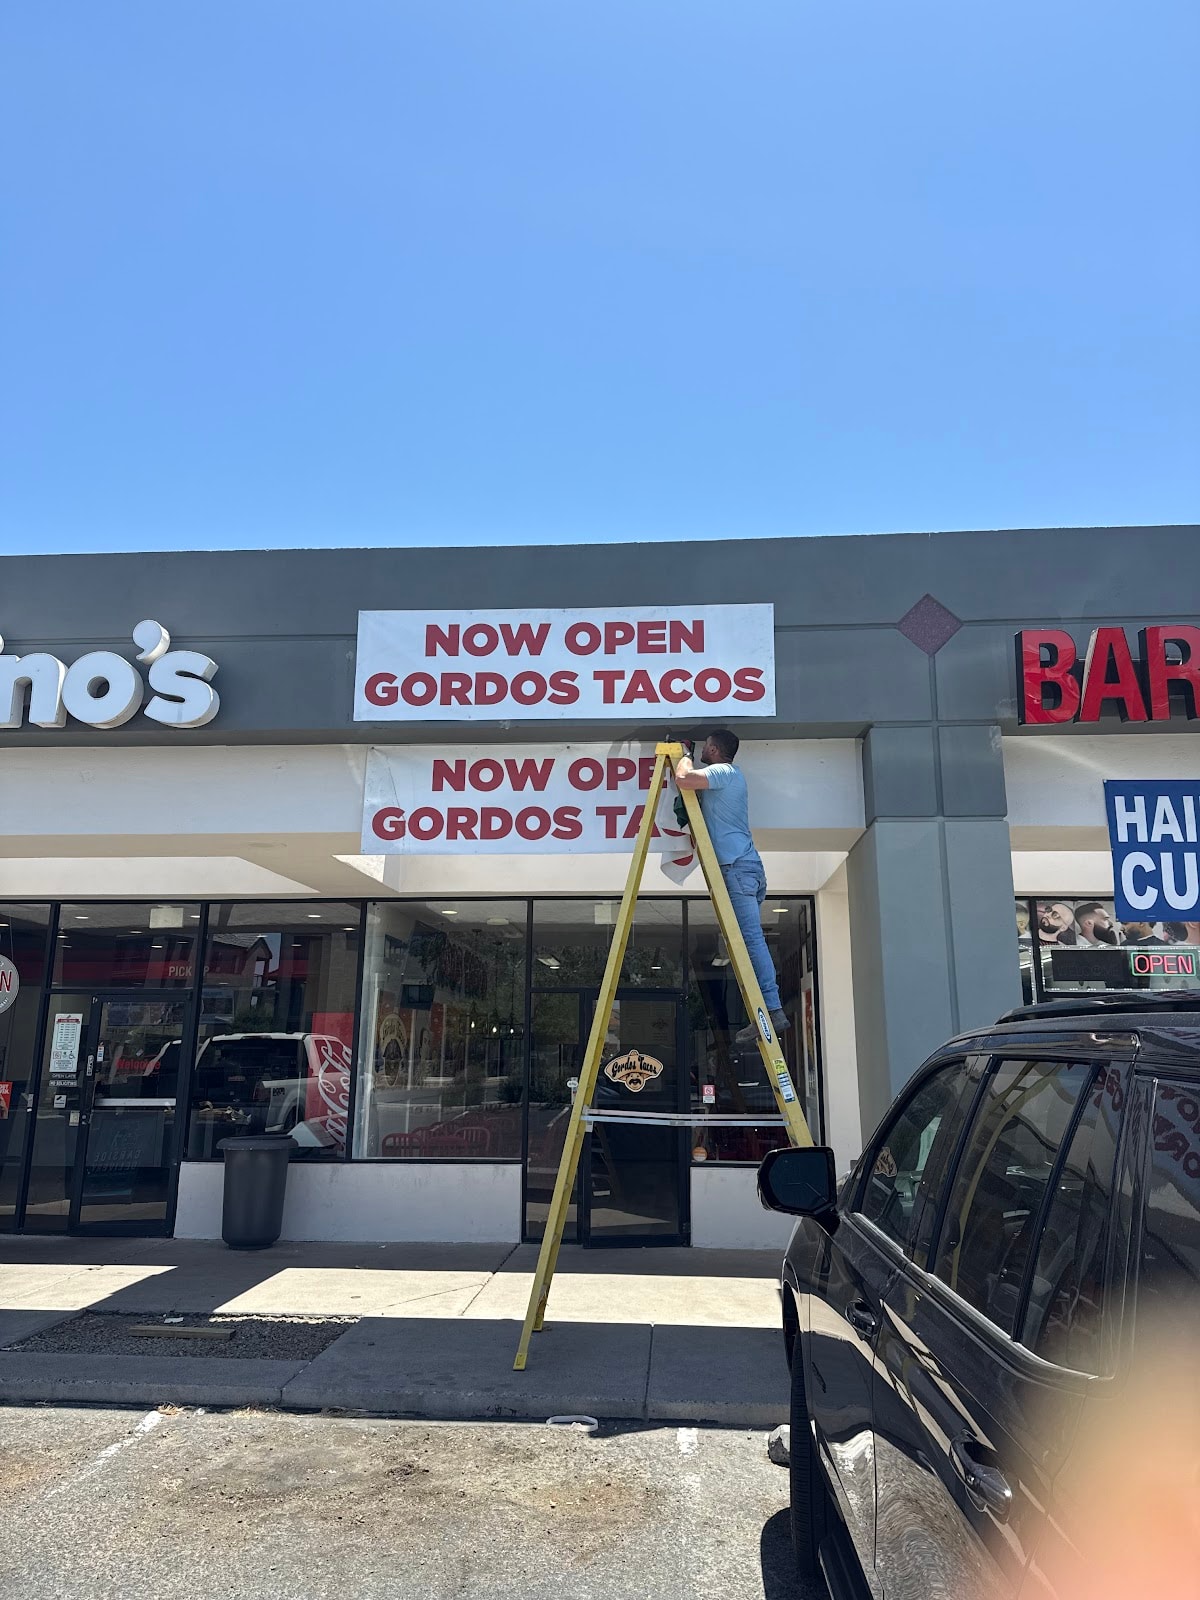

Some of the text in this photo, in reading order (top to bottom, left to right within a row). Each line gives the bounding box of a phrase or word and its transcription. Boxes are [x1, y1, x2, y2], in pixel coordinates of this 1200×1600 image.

[425, 620, 705, 657] NOW OPEN
[0, 620, 219, 729] no's
[364, 667, 766, 707] GORDOS TACOS
[1015, 625, 1200, 725] BAR
[431, 757, 672, 792] NOW OPE
[372, 806, 583, 841] GORDOS
[1114, 795, 1200, 843] HAI
[1121, 851, 1199, 911] CU
[168, 966, 192, 977] PICK
[1134, 954, 1193, 974] OPEN
[611, 1056, 658, 1077] Gordos Tacos
